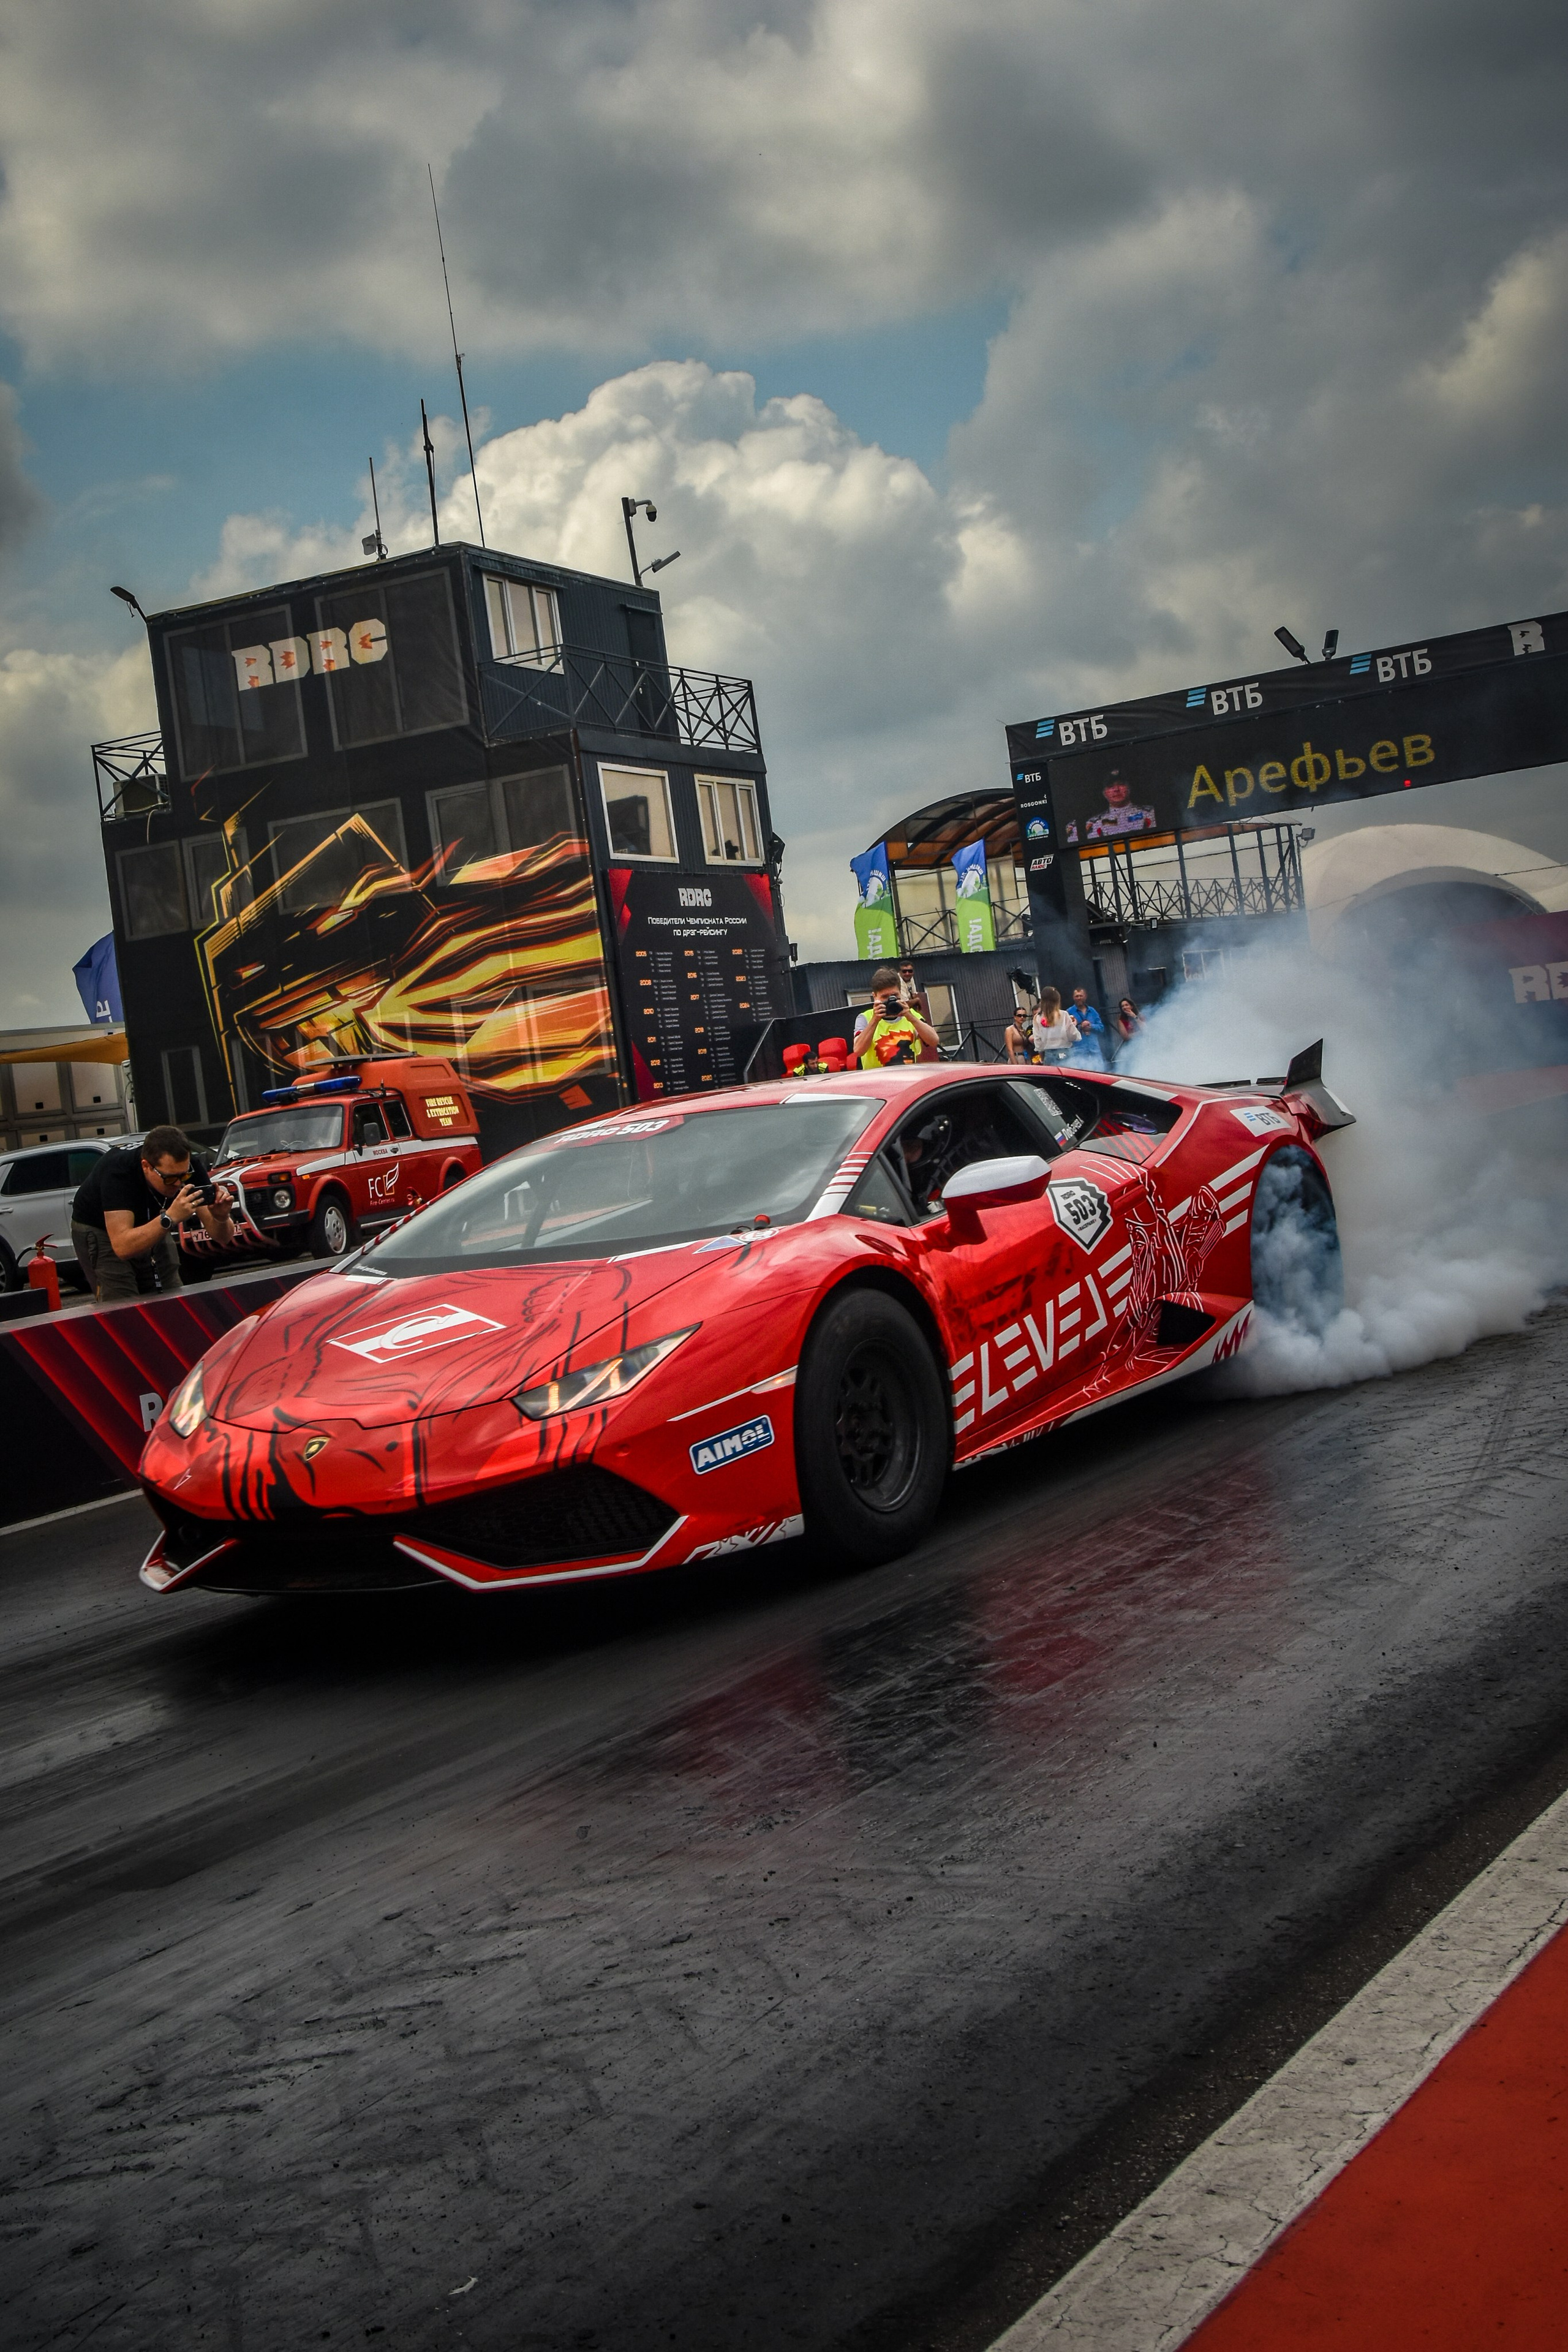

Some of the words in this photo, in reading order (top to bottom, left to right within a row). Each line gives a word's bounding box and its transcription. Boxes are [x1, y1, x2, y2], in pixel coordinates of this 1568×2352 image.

[231, 619, 388, 692] RDRC
[1376, 648, 1432, 682] ВТБ
[1211, 682, 1263, 715] ВТБ
[1058, 714, 1108, 746] ВТБ
[1024, 772, 1041, 783] ВТБ
[1187, 734, 1435, 809] Арефьев
[1020, 799, 1047, 808] ROSGONKI
[1033, 858, 1052, 866] АВТО
[678, 888, 712, 907] RDRC
[426, 1098, 437, 1107] FIRE
[436, 1096, 453, 1106] RESCUE
[430, 1106, 459, 1117] EXTRICATION
[1255, 1112, 1281, 1126] ВТБ
[439, 1117, 453, 1126] TEAM
[616, 1120, 669, 1136] 503
[368, 1177, 383, 1199] FC
[1063, 1194, 1096, 1225] 503
[698, 1424, 770, 1468] AIMOL
